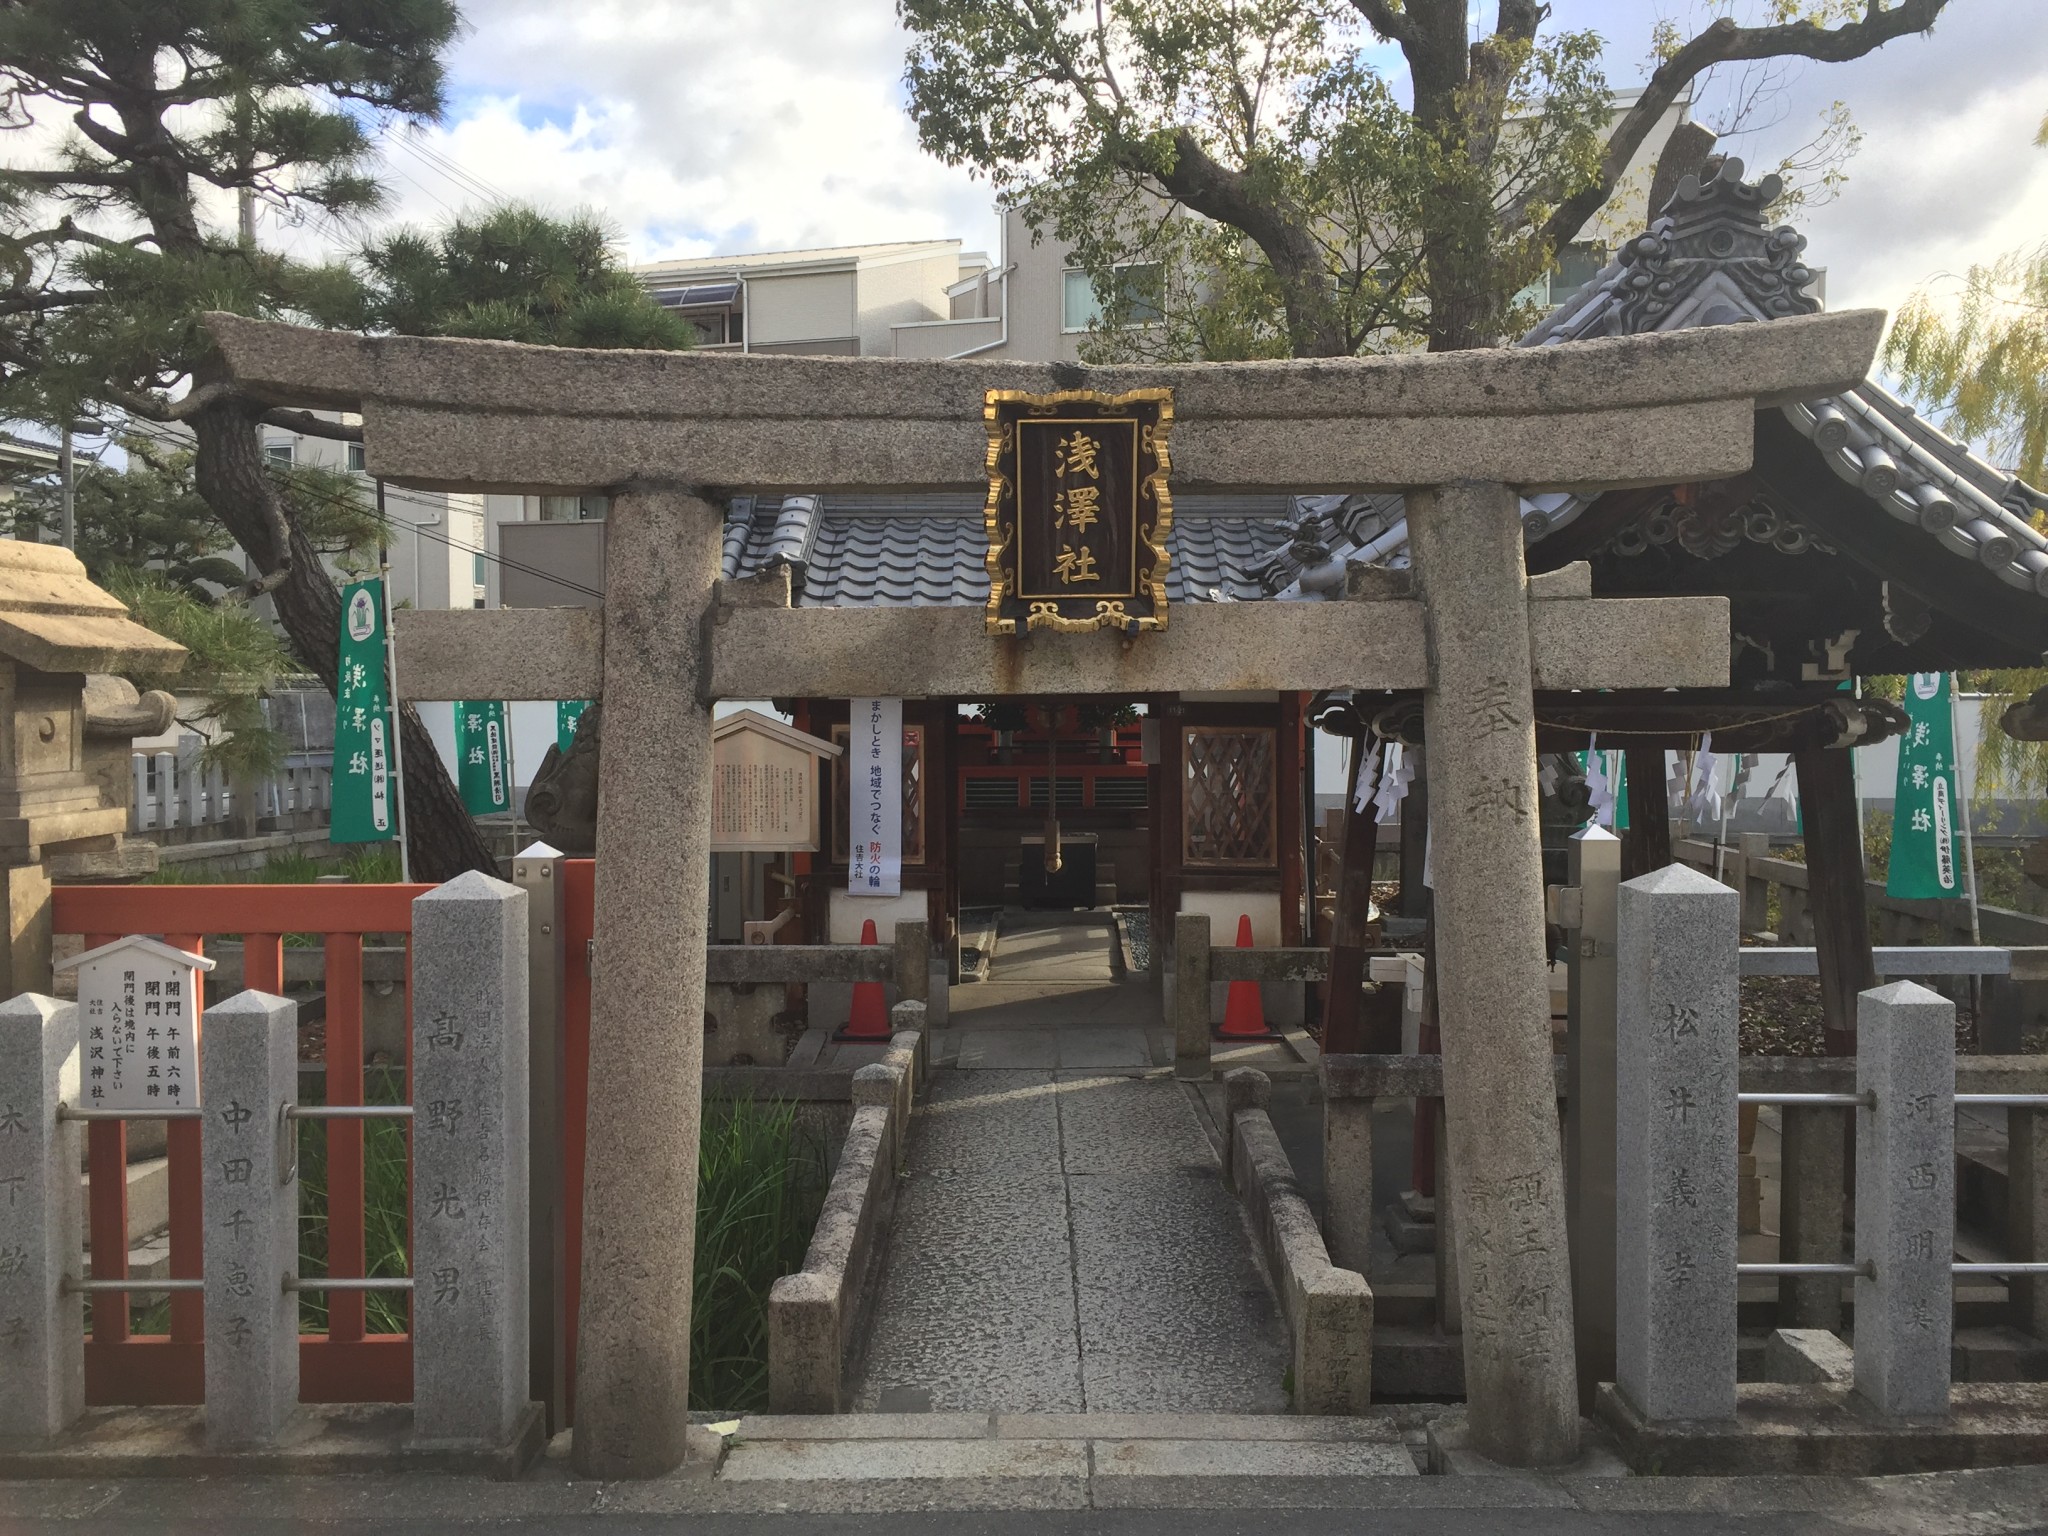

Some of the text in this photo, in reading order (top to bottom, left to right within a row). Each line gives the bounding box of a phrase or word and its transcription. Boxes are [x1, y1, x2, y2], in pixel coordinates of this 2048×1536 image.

[1052, 430, 1100, 585] 浅澤社
[1465, 675, 1529, 825] 奉納
[870, 765, 882, 836] 地域でつなぐ
[854, 845, 864, 880] 住吉大社
[869, 841, 881, 887] 防火の輪
[123, 970, 135, 1054] 閉門後は境内に
[145, 981, 161, 1098] 閉門 午後五時
[165, 981, 181, 1097] 開門 午前六時
[89, 1026, 105, 1099] 浅沢神社
